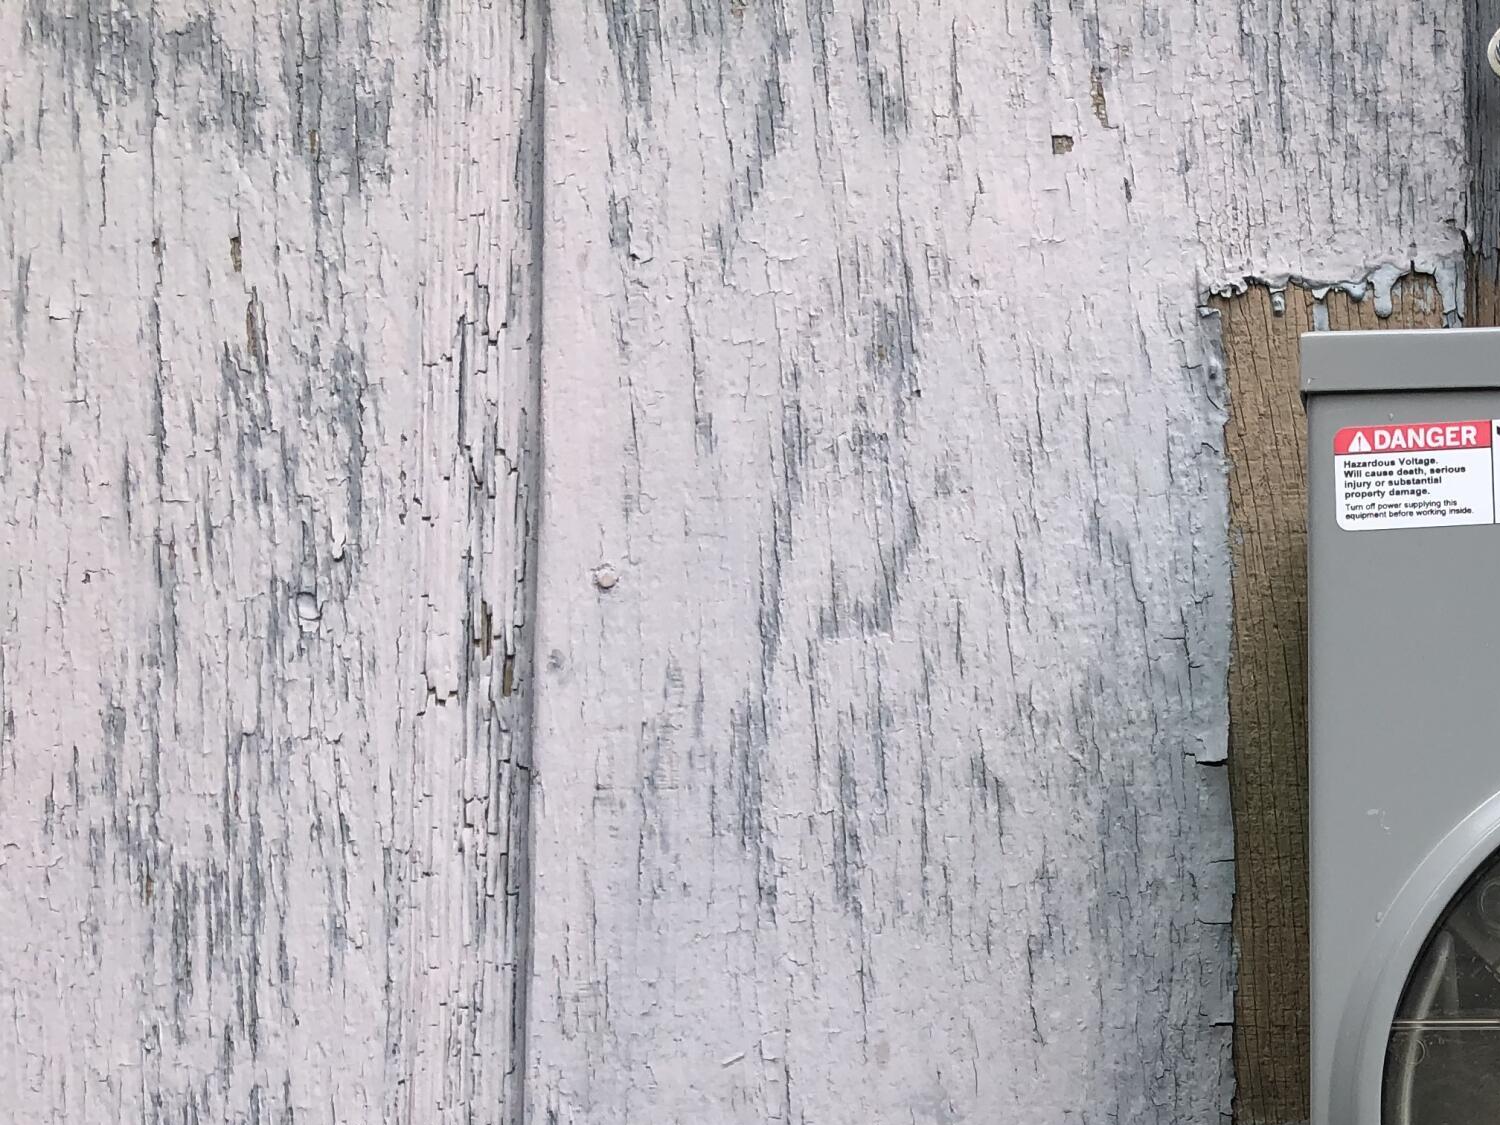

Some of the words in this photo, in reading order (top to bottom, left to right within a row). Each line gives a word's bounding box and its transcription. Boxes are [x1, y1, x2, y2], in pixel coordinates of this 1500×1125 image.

[1374, 426, 1477, 450] DANGER
[1344, 460, 1395, 468] Hazardous
[1399, 457, 1438, 467] Voltage.
[1344, 470, 1362, 478] Will
[1397, 467, 1426, 476] death,
[1430, 465, 1466, 474] serious
[1344, 480, 1371, 490] injury
[1388, 476, 1442, 486] substantial
[1345, 490, 1385, 500] property
[1389, 487, 1430, 497] damage.
[1345, 503, 1363, 511] Turn
[1366, 502, 1376, 510] off
[1377, 503, 1401, 511] power
[1404, 499, 1441, 509] supplying
[1345, 511, 1387, 520] equipment
[1389, 510, 1413, 518] before
[1416, 508, 1446, 517] working
[1449, 506, 1474, 514] inside.
